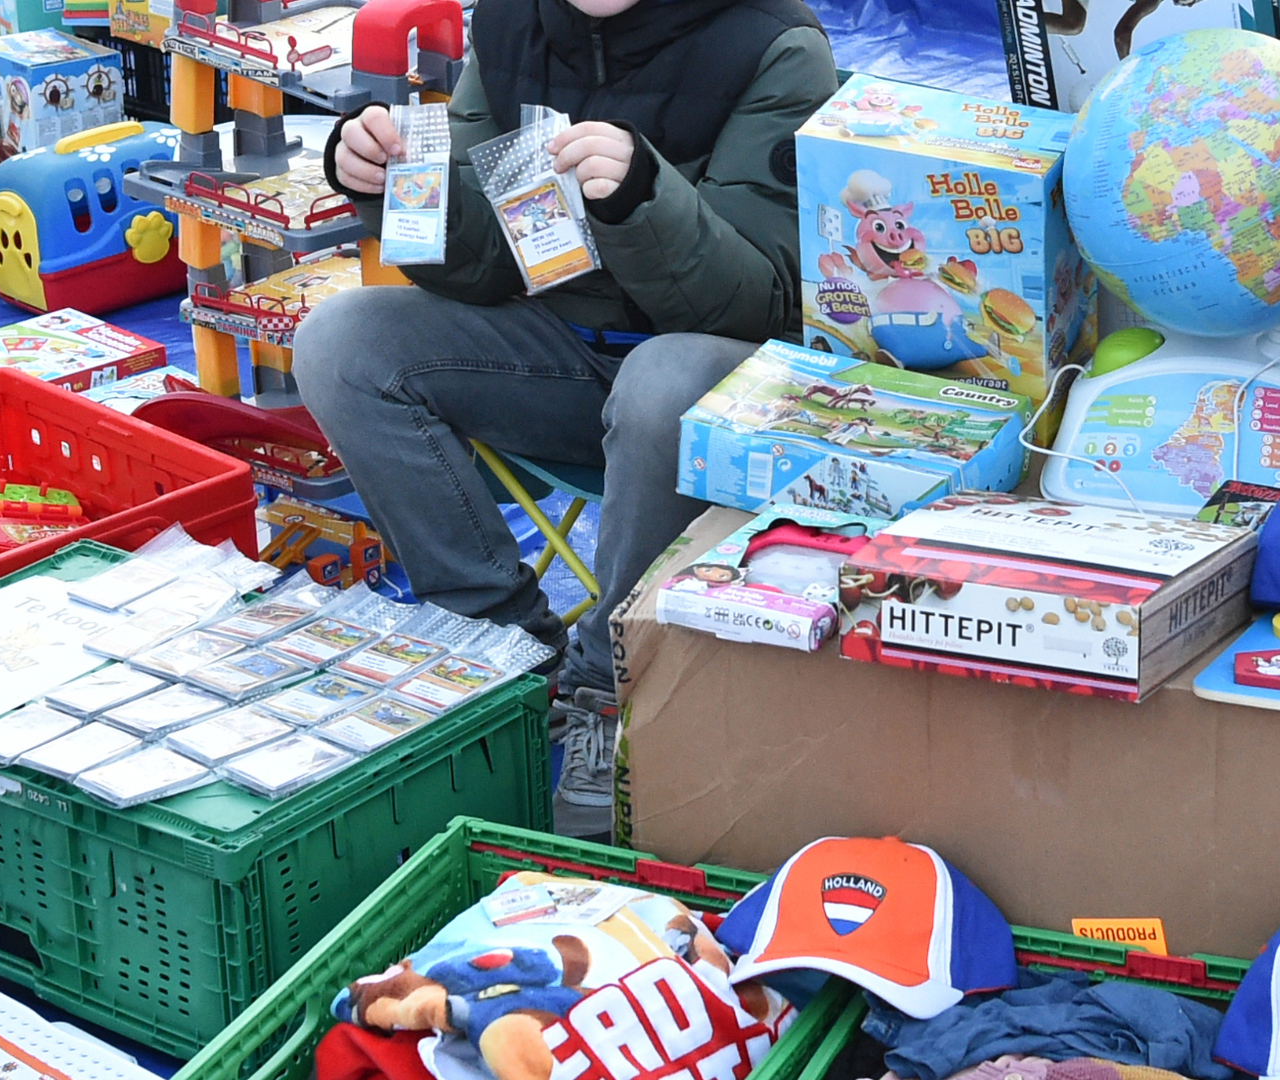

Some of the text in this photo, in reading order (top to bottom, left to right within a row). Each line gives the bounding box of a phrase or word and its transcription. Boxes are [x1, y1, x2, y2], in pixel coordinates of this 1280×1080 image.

[241, 70, 273, 78] TEAM
[926, 172, 999, 199] Holle
[949, 197, 1019, 223] Bolle
[817, 281, 838, 294] Nu
[815, 292, 869, 307] GROTER
[820, 302, 871, 317] & Beter!
[940, 385, 1018, 409] Country
[971, 507, 1102, 532] HITTEPIT
[14, 596, 47, 615] Te
[888, 605, 1024, 648] HITTEPIT
[824, 876, 883, 898] HOLLAND
[1078, 926, 1158, 942] PRODUCTS
